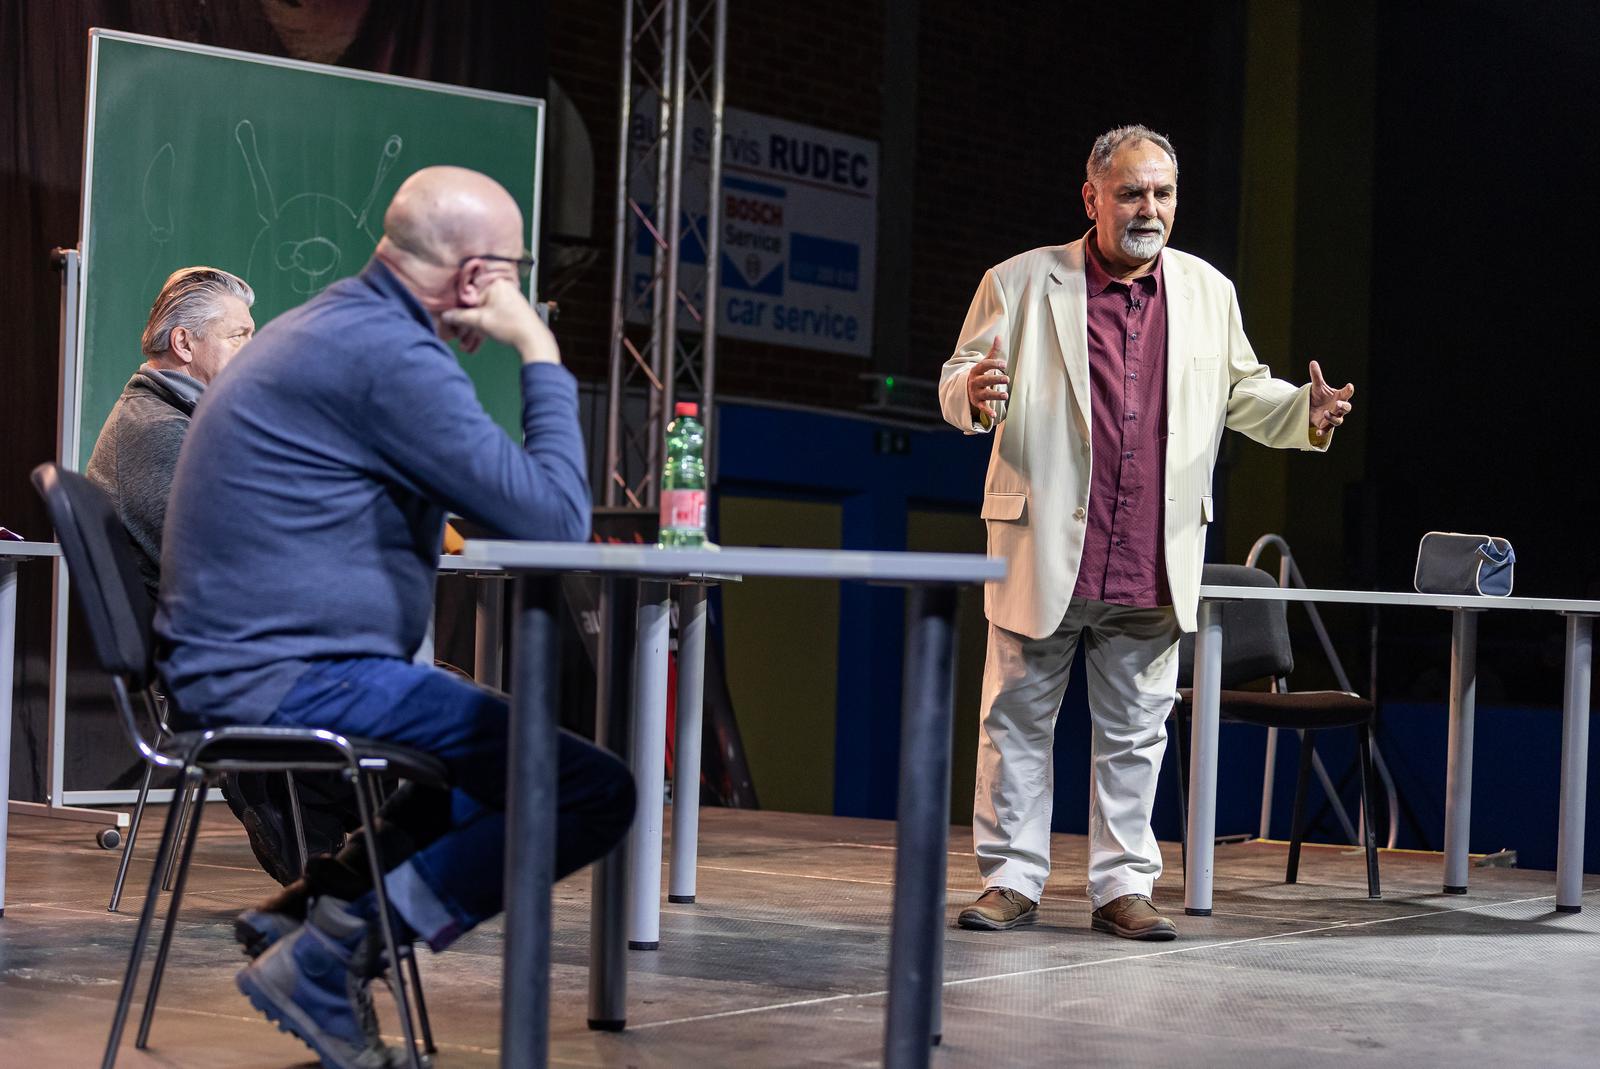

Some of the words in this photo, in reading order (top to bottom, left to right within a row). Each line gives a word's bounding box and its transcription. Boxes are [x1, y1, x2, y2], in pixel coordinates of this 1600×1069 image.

[692, 126, 761, 166] srvis
[770, 134, 869, 188] RUDEC
[725, 196, 783, 227] BOSCH
[725, 222, 782, 254] Service
[727, 298, 766, 327] car
[773, 303, 858, 342] service
